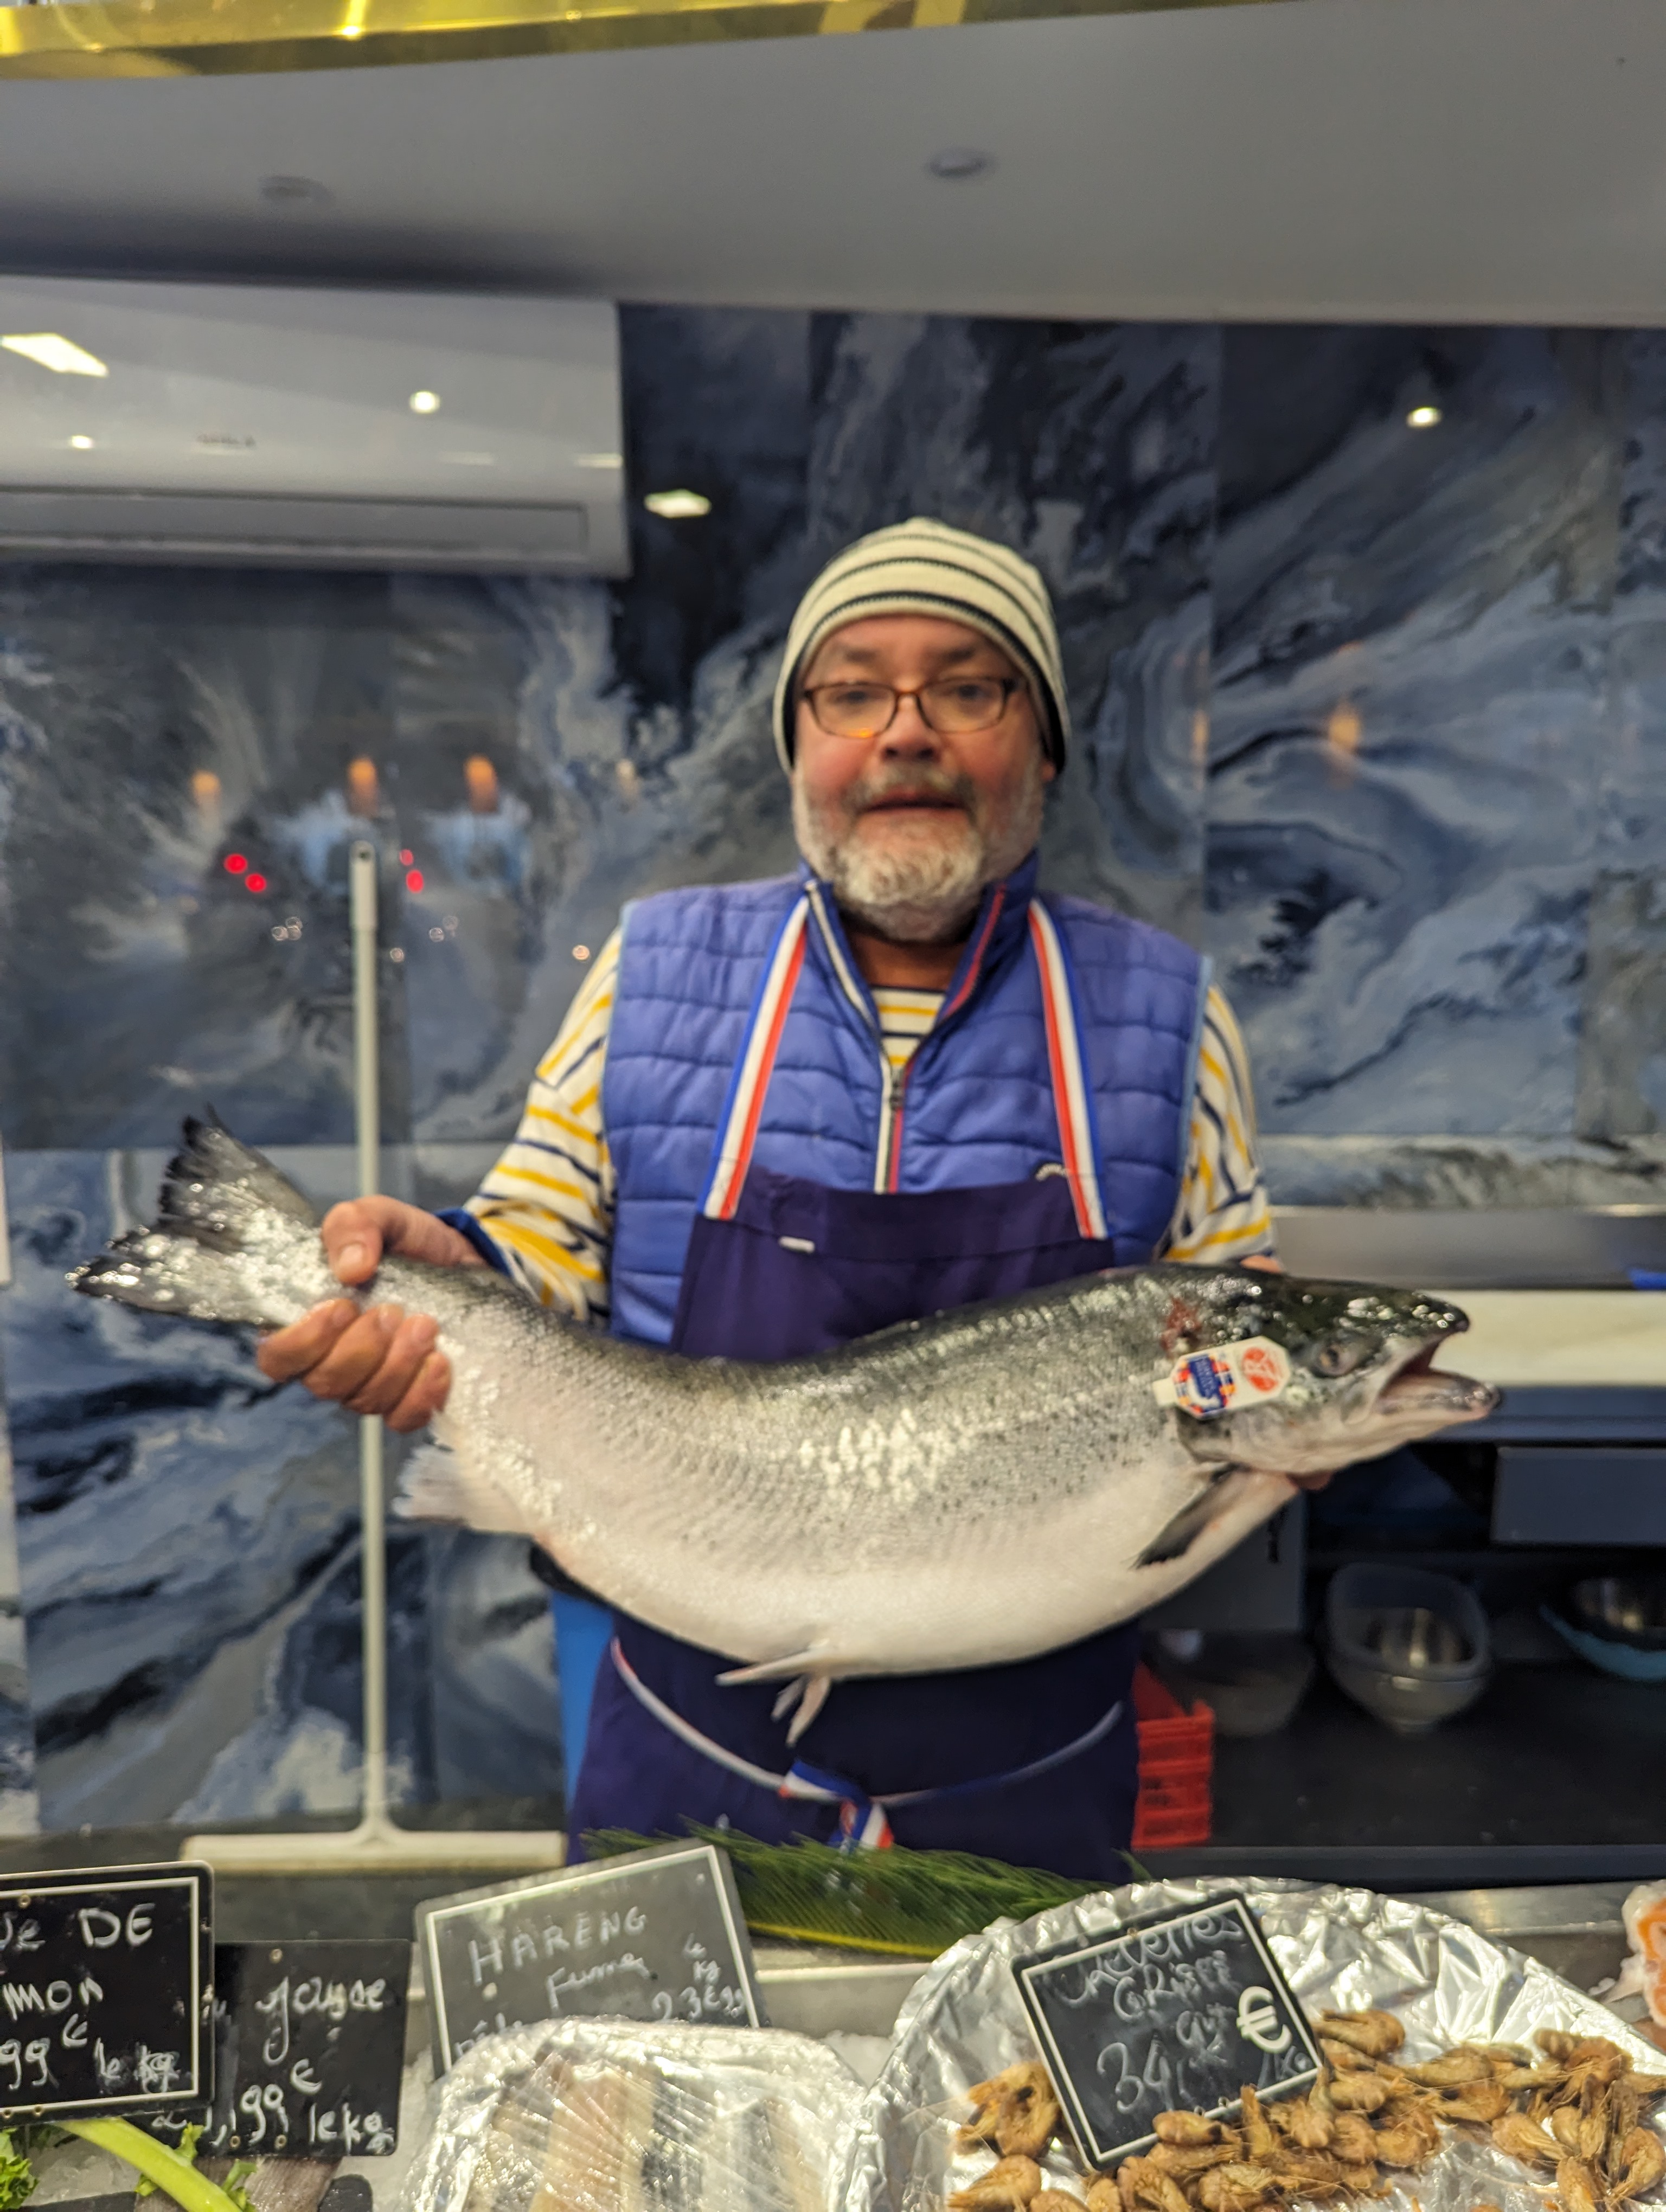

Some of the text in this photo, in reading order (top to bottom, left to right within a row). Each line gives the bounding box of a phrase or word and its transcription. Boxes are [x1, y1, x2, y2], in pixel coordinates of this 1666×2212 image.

[78, 1903, 155, 1949] DE
[468, 1906, 647, 1985] HARENG
[1236, 1986, 1293, 2054] €
